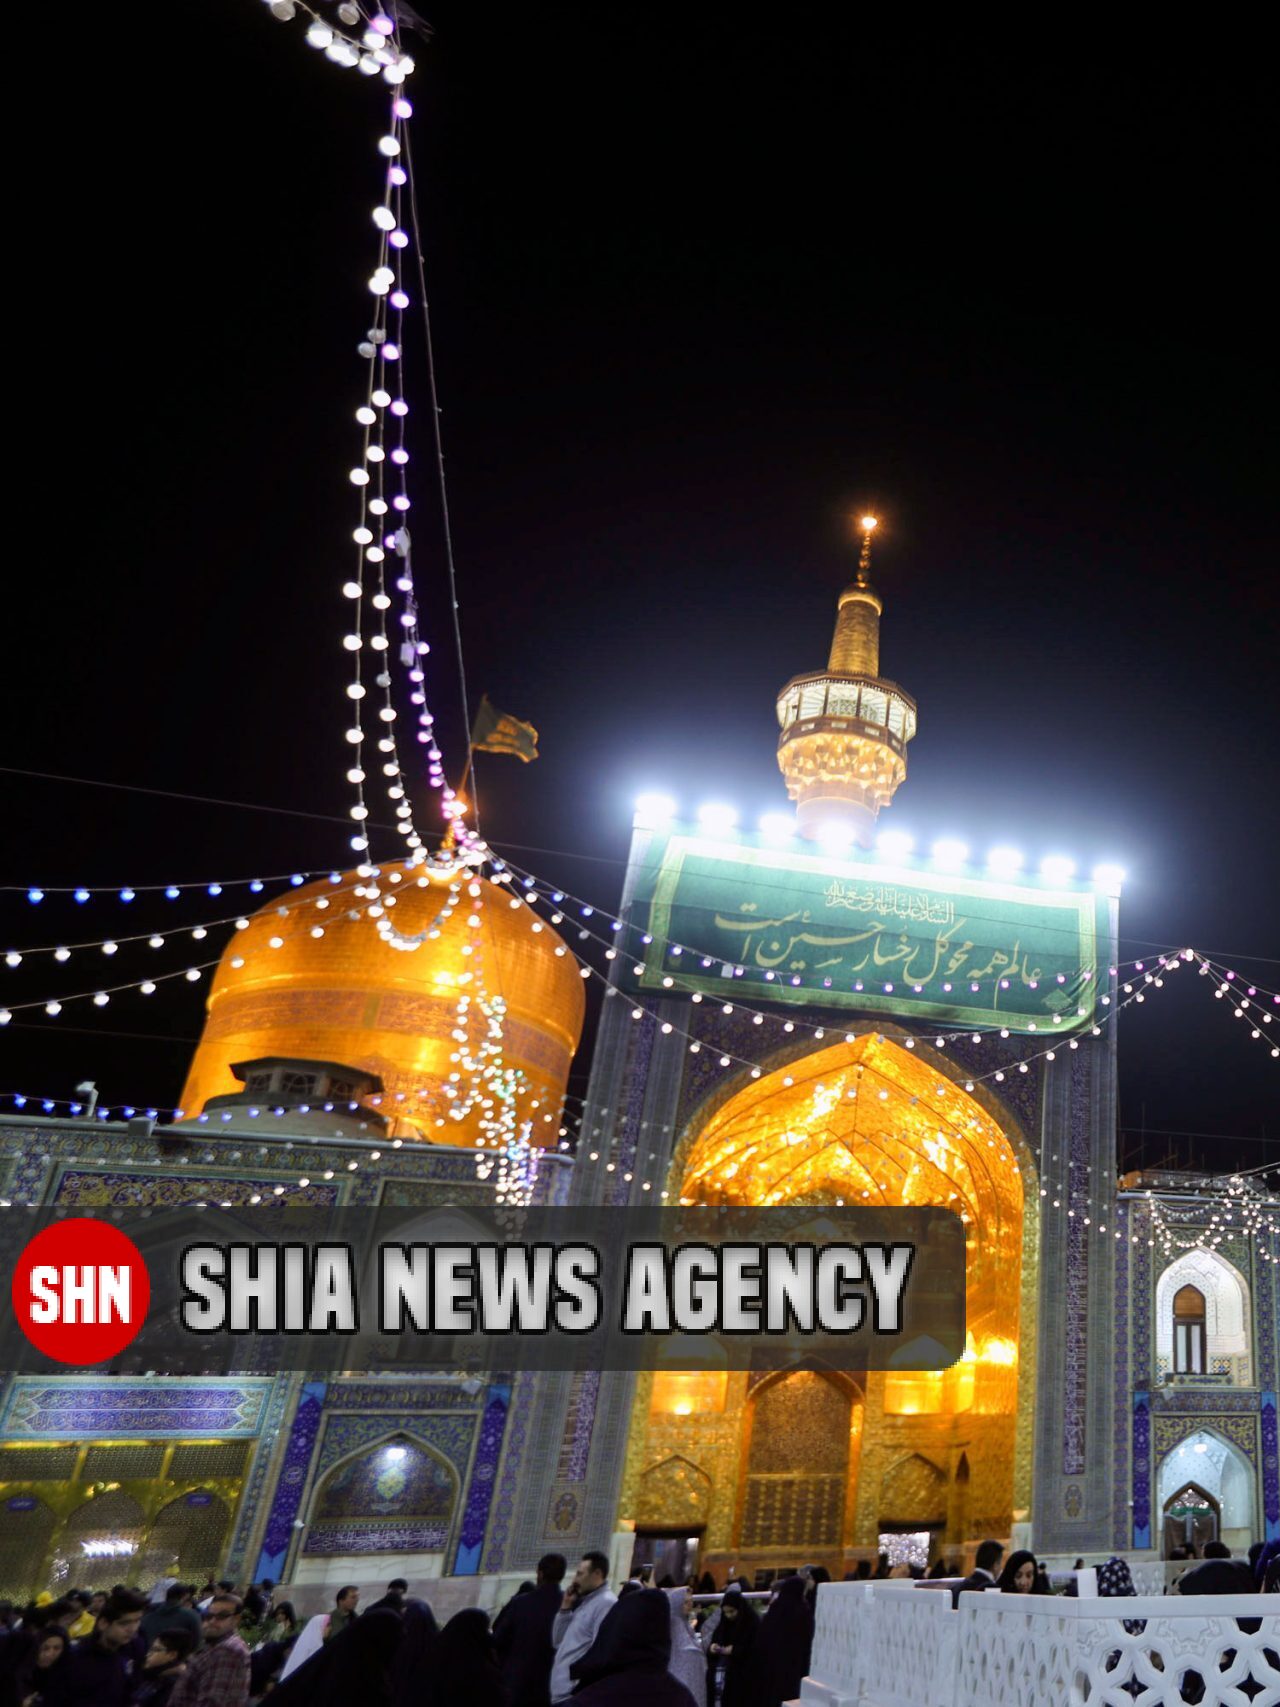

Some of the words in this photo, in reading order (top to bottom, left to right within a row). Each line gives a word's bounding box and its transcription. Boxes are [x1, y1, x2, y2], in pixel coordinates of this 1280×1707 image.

[943, 940, 974, 976] محو
[966, 950, 1009, 979] همه
[993, 940, 1043, 1011] عالم
